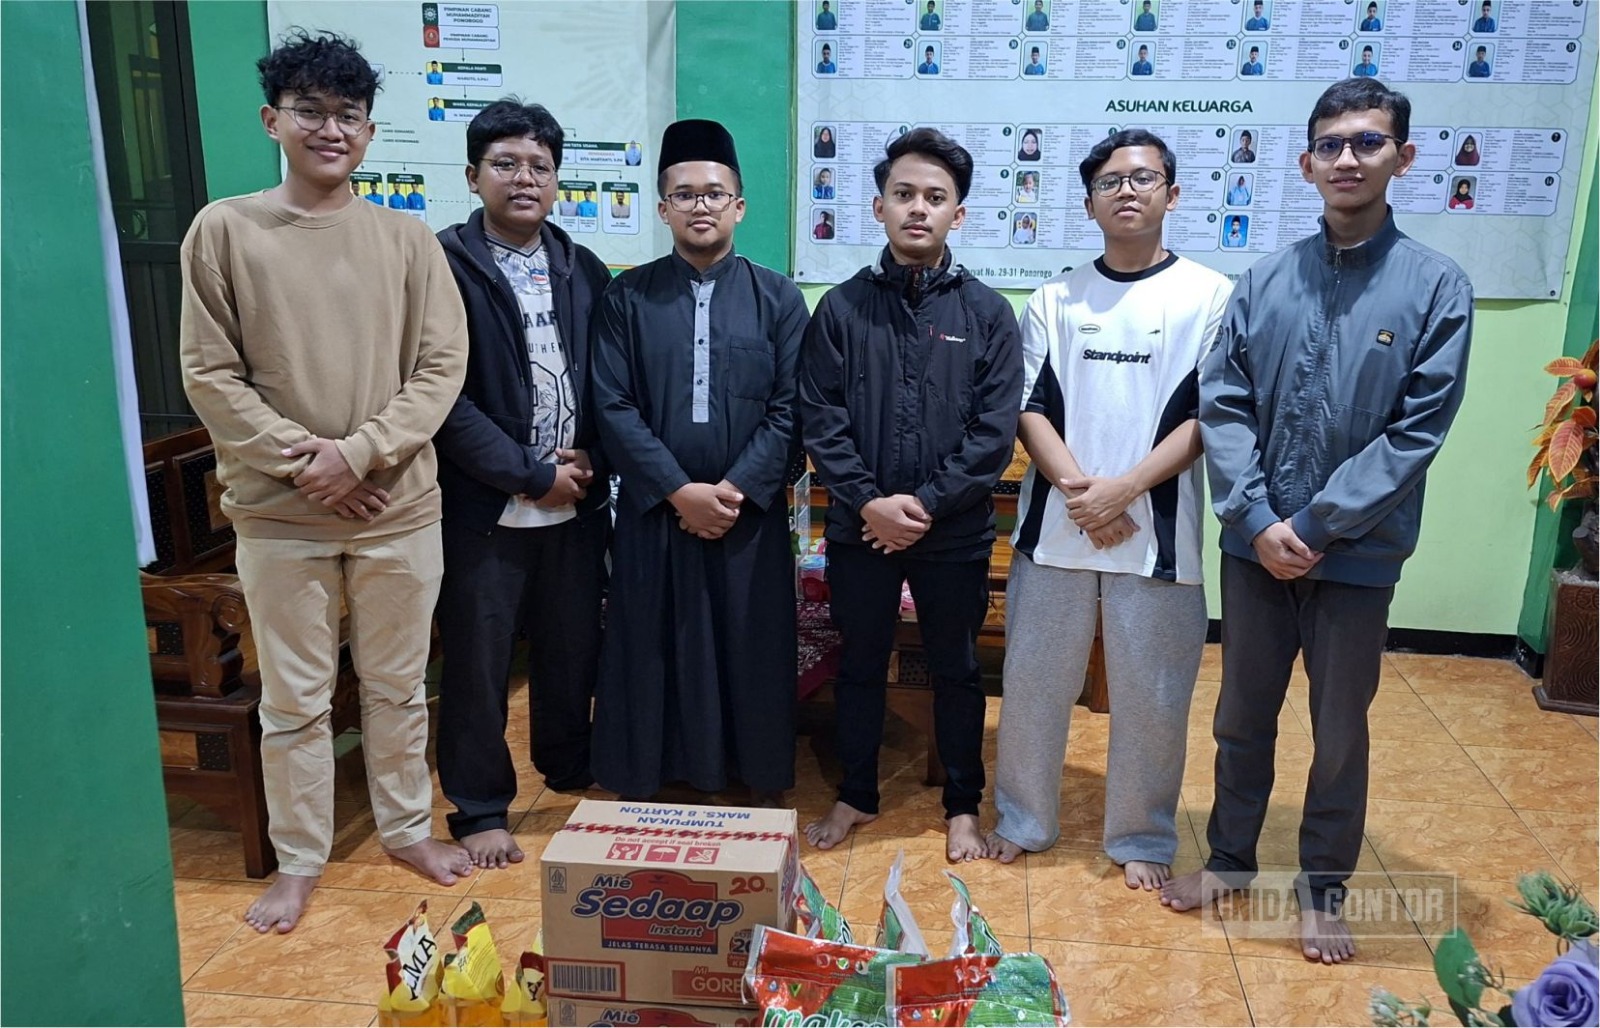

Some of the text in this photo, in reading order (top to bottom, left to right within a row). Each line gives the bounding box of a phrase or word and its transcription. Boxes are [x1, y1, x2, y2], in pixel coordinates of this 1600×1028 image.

[1105, 99, 1253, 113] ASUHAN KELUARGA
[985, 269, 997, 277] No.
[998, 269, 1017, 277] 29-31
[1020, 269, 1052, 279] Ponorogo
[1082, 348, 1151, 364] Standpoint
[620, 806, 684, 817] KARTON
[703, 811, 751, 820] MAKS.
[637, 816, 725, 828] TUMPUKAN
[593, 875, 633, 890] Mie
[729, 876, 766, 896] 20
[573, 889, 742, 928] Sedaap
[650, 925, 703, 937] Instant
[607, 941, 712, 953] JELAS TERASA SEDAPNYA
[602, 1009, 639, 1024] Mie
